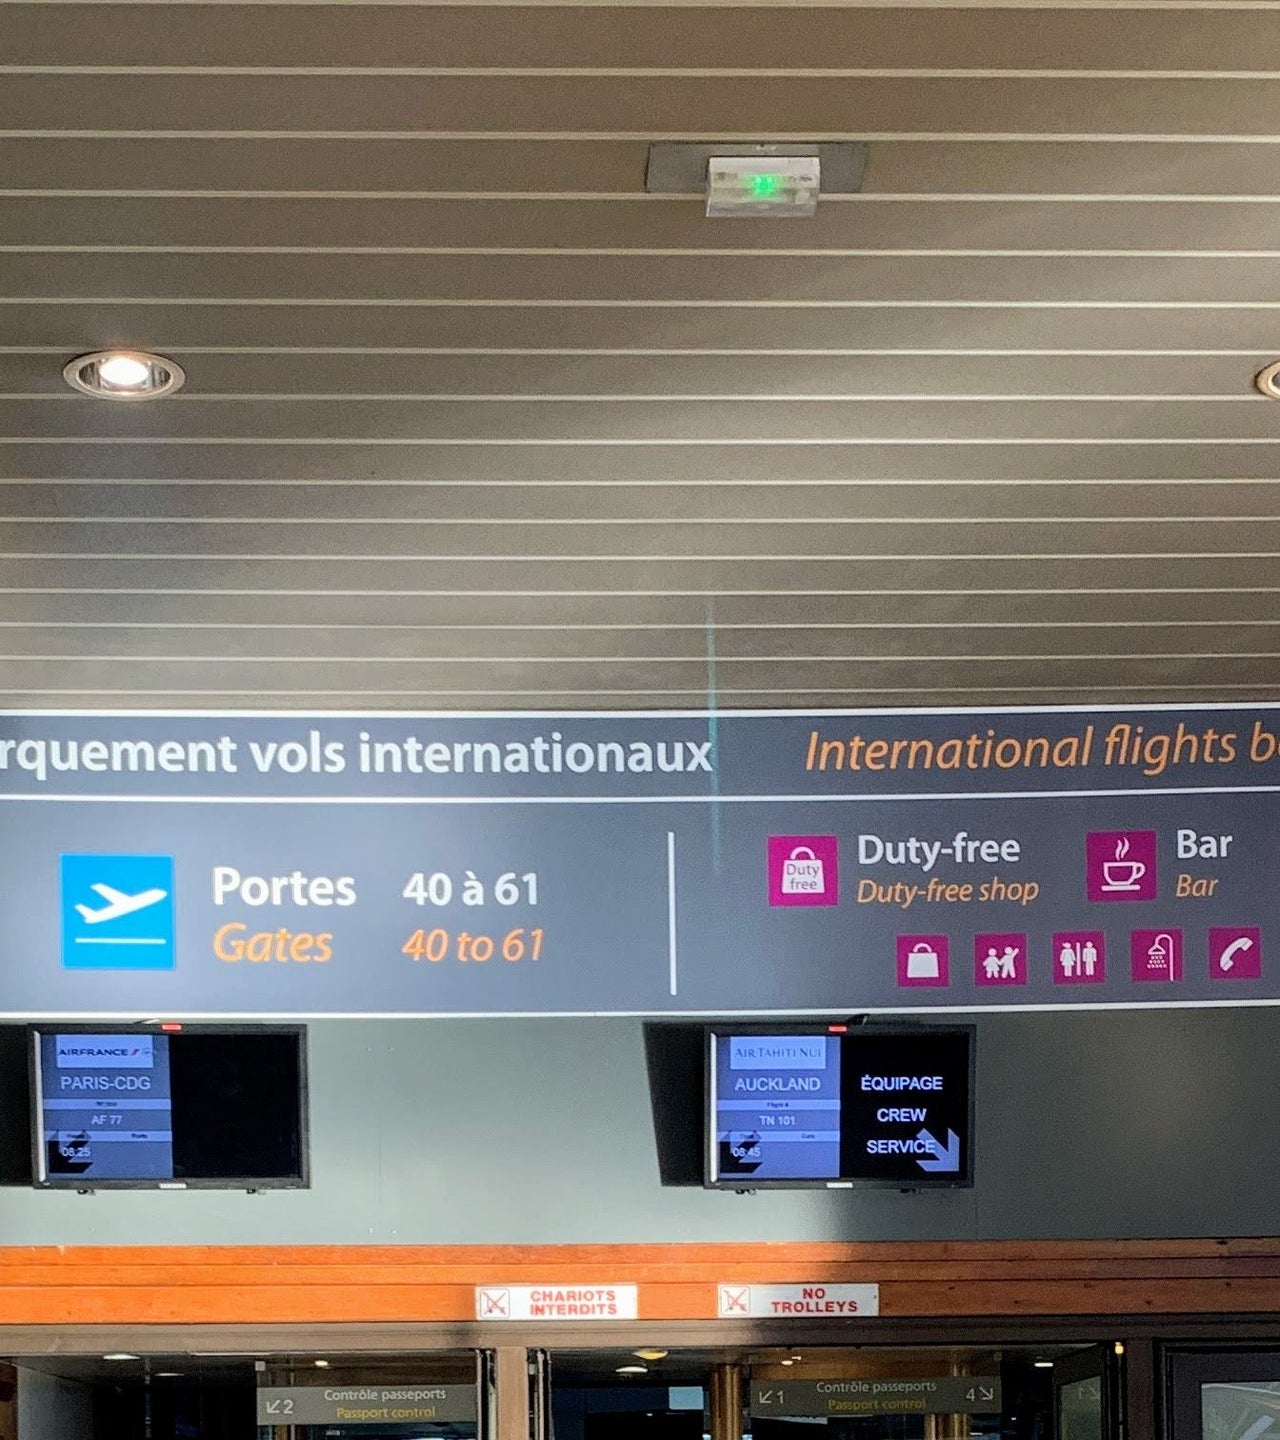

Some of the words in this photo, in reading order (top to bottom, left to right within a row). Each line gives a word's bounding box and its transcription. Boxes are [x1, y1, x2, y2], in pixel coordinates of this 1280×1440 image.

[249, 730, 346, 773] vols
[358, 731, 713, 774] internationaux
[805, 725, 1095, 771] International
[1104, 722, 1236, 777] flights
[1177, 829, 1233, 859] Bar
[858, 831, 1021, 872] Duty-free
[786, 864, 820, 877] Duty
[212, 866, 357, 907] Portes
[402, 872, 451, 906] 40
[461, 870, 484, 906] à
[494, 872, 537, 906] 61
[790, 878, 817, 890] free
[1175, 873, 1217, 899] Bar
[856, 878, 974, 908] Duty-free
[980, 878, 1040, 905] shop
[213, 922, 333, 963] Gates
[402, 928, 450, 963] 40
[456, 932, 496, 963] to
[501, 928, 544, 962] 61
[736, 1048, 756, 1058] AIR
[758, 1047, 796, 1058] TAHITI
[60, 1076, 151, 1090] PARIS-CDG
[735, 1077, 821, 1092] AUCKLAND
[861, 1074, 943, 1092] ÉQUIPAGE
[91, 1115, 107, 1125] AF
[109, 1115, 123, 1125] 77
[759, 1115, 775, 1126] TN
[778, 1115, 796, 1126] 101
[877, 1107, 927, 1123] CREW
[866, 1140, 936, 1155] SERVICE
[530, 1290, 616, 1302] CHARIOTS
[802, 1288, 826, 1299] NO
[530, 1303, 617, 1315] INTERDITS
[771, 1300, 858, 1312] TROLLEYS
[816, 1381, 869, 1394] Contrôle
[873, 1381, 937, 1395] passeports
[966, 1388, 975, 1401] 4
[324, 1389, 378, 1401] Contrôle
[381, 1389, 447, 1402] passeports
[776, 1391, 784, 1404] 1
[283, 1400, 294, 1414] 2
[828, 1400, 879, 1411] Passport
[883, 1399, 926, 1410] control
[336, 1406, 389, 1420] Passport
[392, 1406, 436, 1418] control
